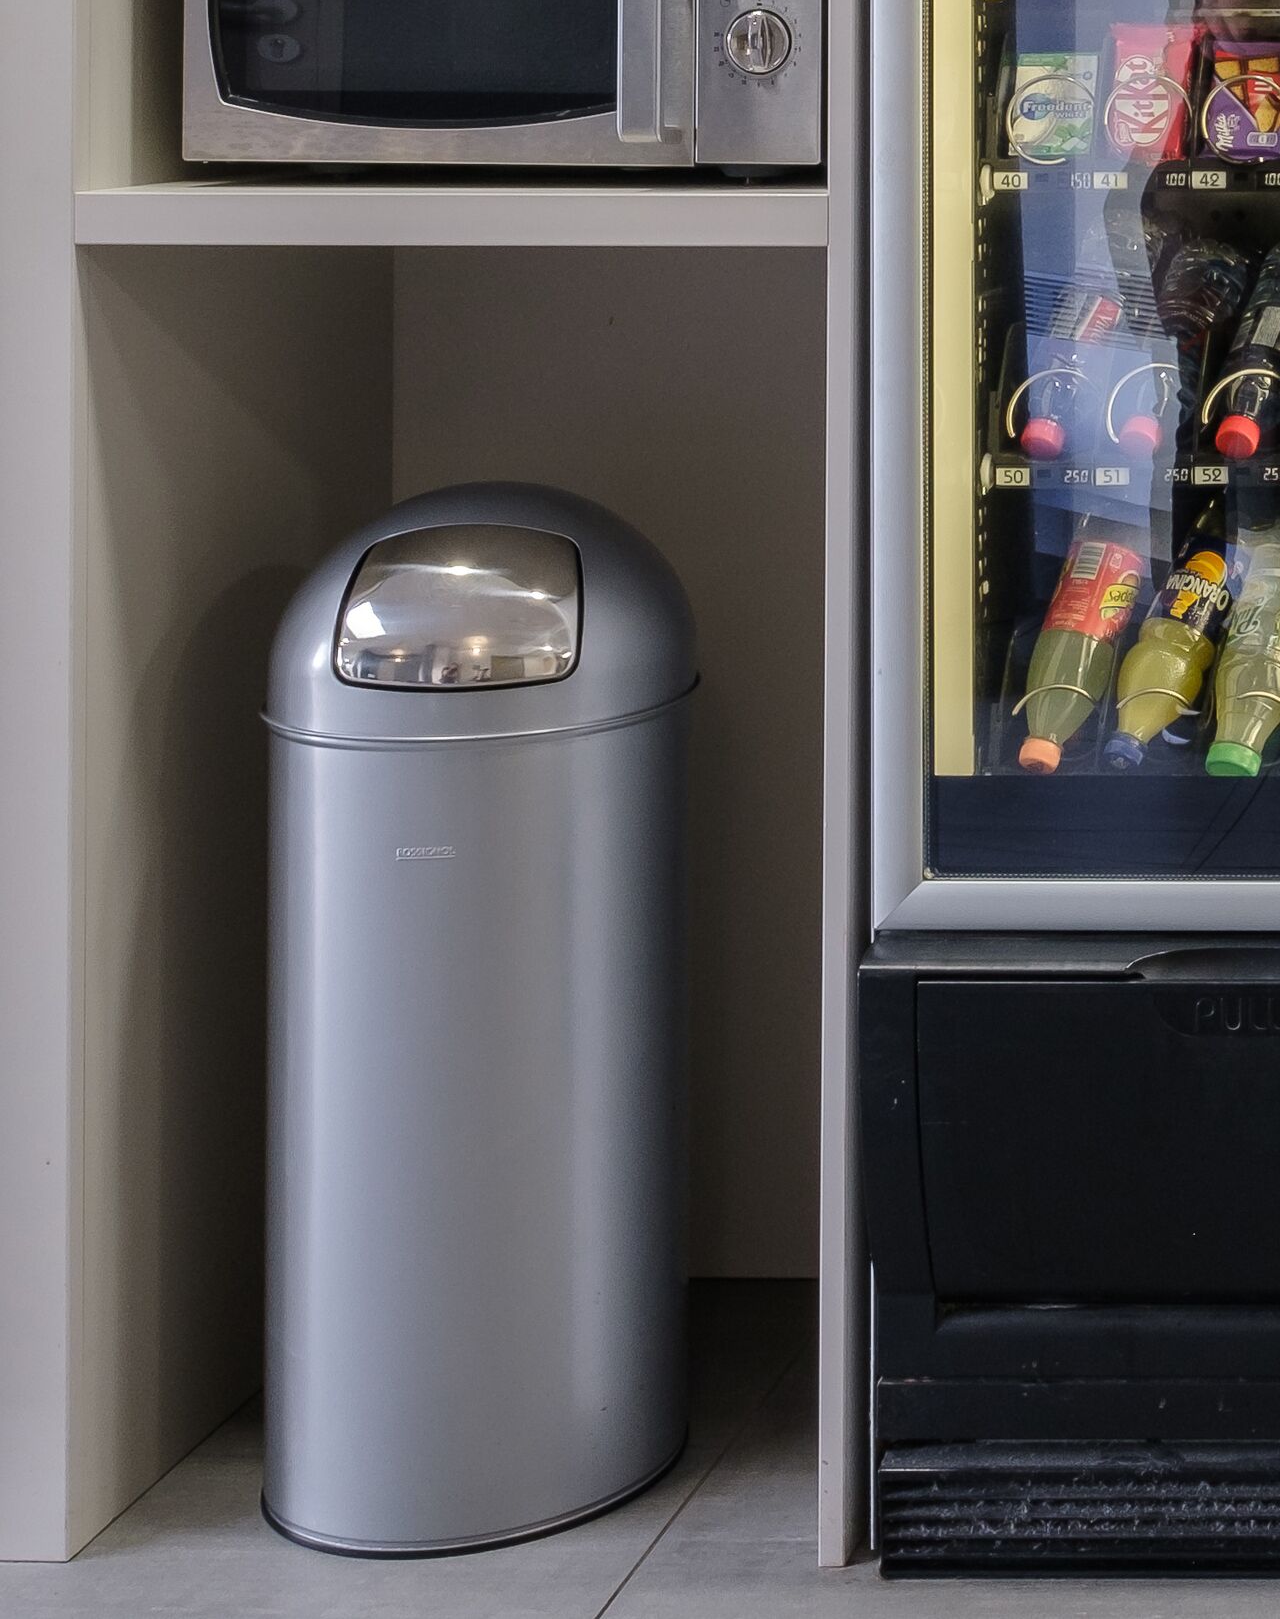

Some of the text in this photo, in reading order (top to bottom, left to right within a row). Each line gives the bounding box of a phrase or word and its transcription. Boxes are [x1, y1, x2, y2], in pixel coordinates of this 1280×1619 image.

[1214, 113, 1235, 152] Milka
[1001, 175, 1022, 188] 40
[1100, 174, 1119, 187] 41
[1199, 173, 1220, 186] 42
[1003, 470, 1023, 484] 50
[1103, 469, 1121, 483] 51
[1201, 468, 1222, 482] 52
[1166, 572, 1230, 612] ORANGINA
